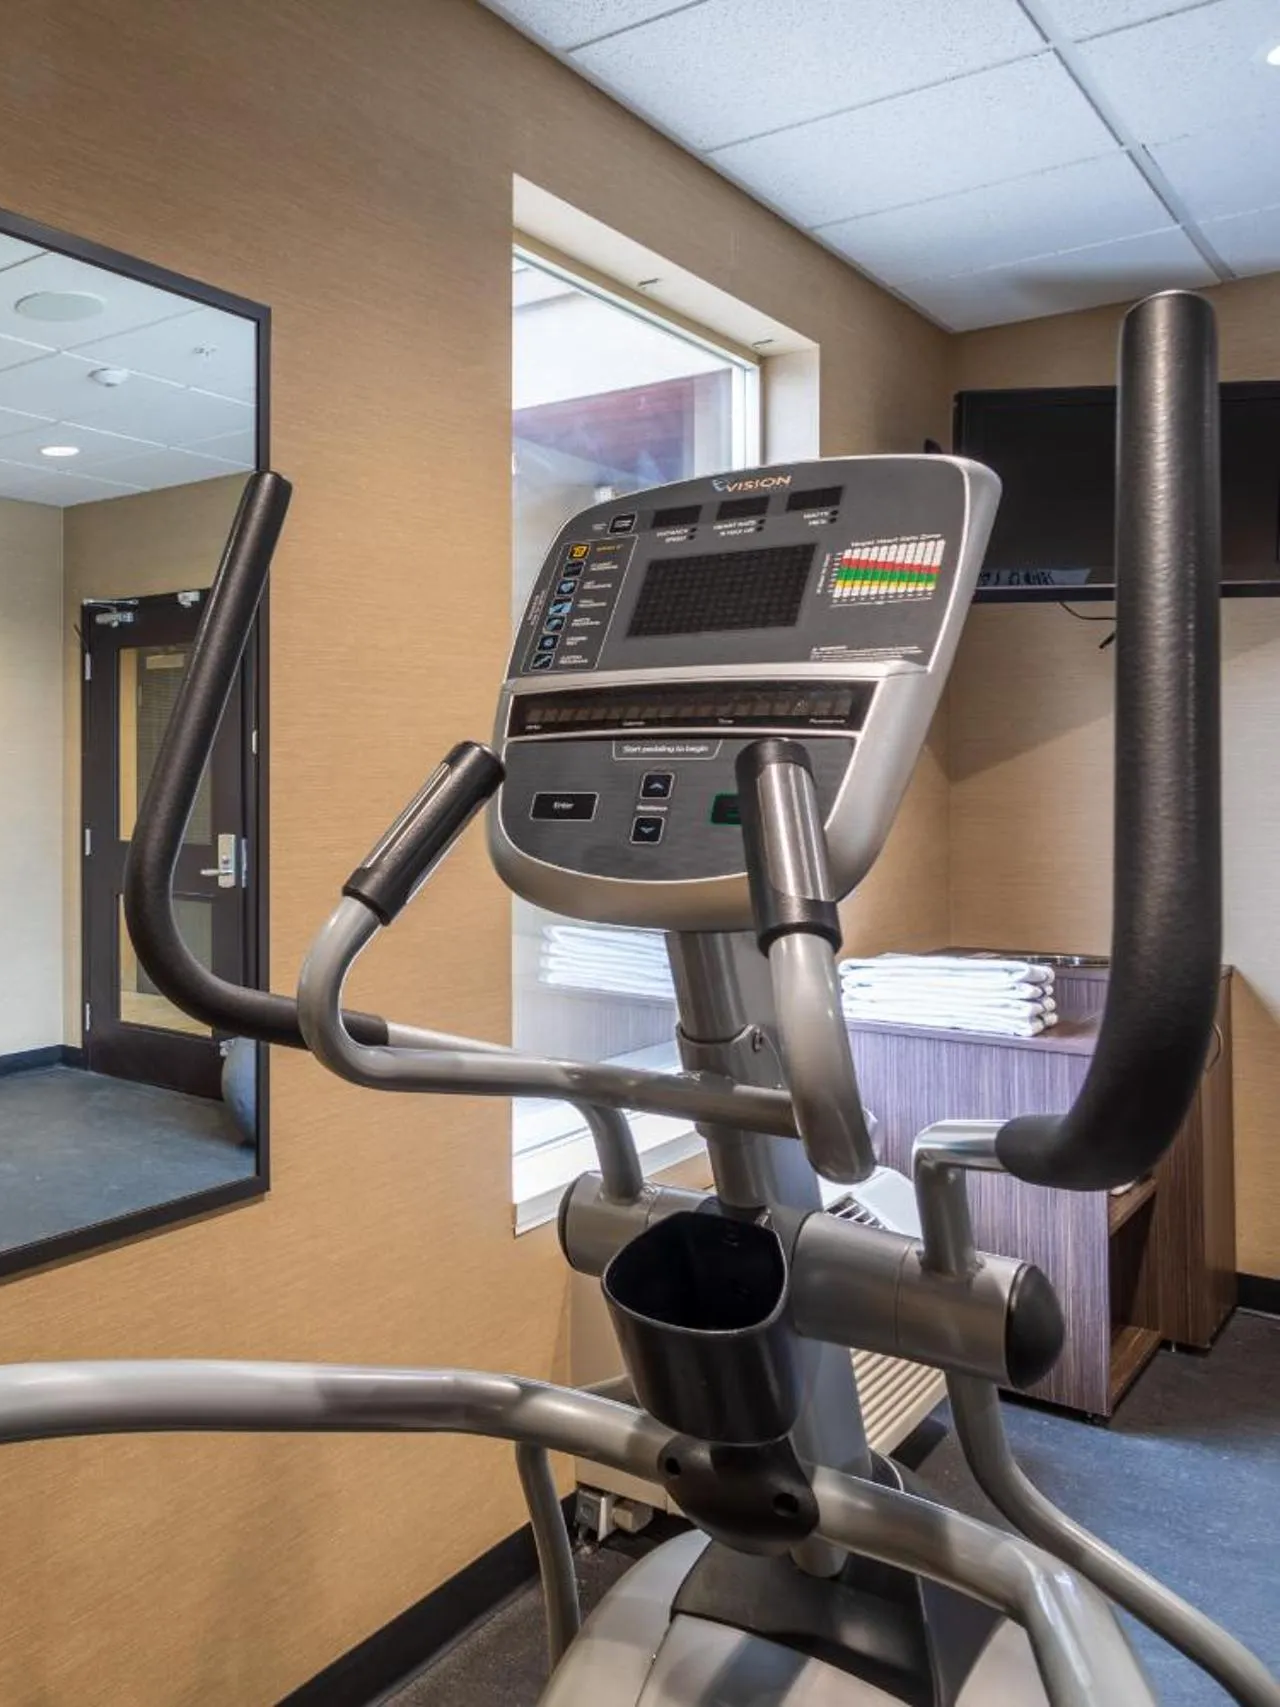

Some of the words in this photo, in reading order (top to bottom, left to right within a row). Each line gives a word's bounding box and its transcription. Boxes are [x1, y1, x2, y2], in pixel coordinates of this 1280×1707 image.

[726, 475, 793, 493] VISION
[623, 745, 640, 753] Start
[553, 801, 575, 809] Enter
